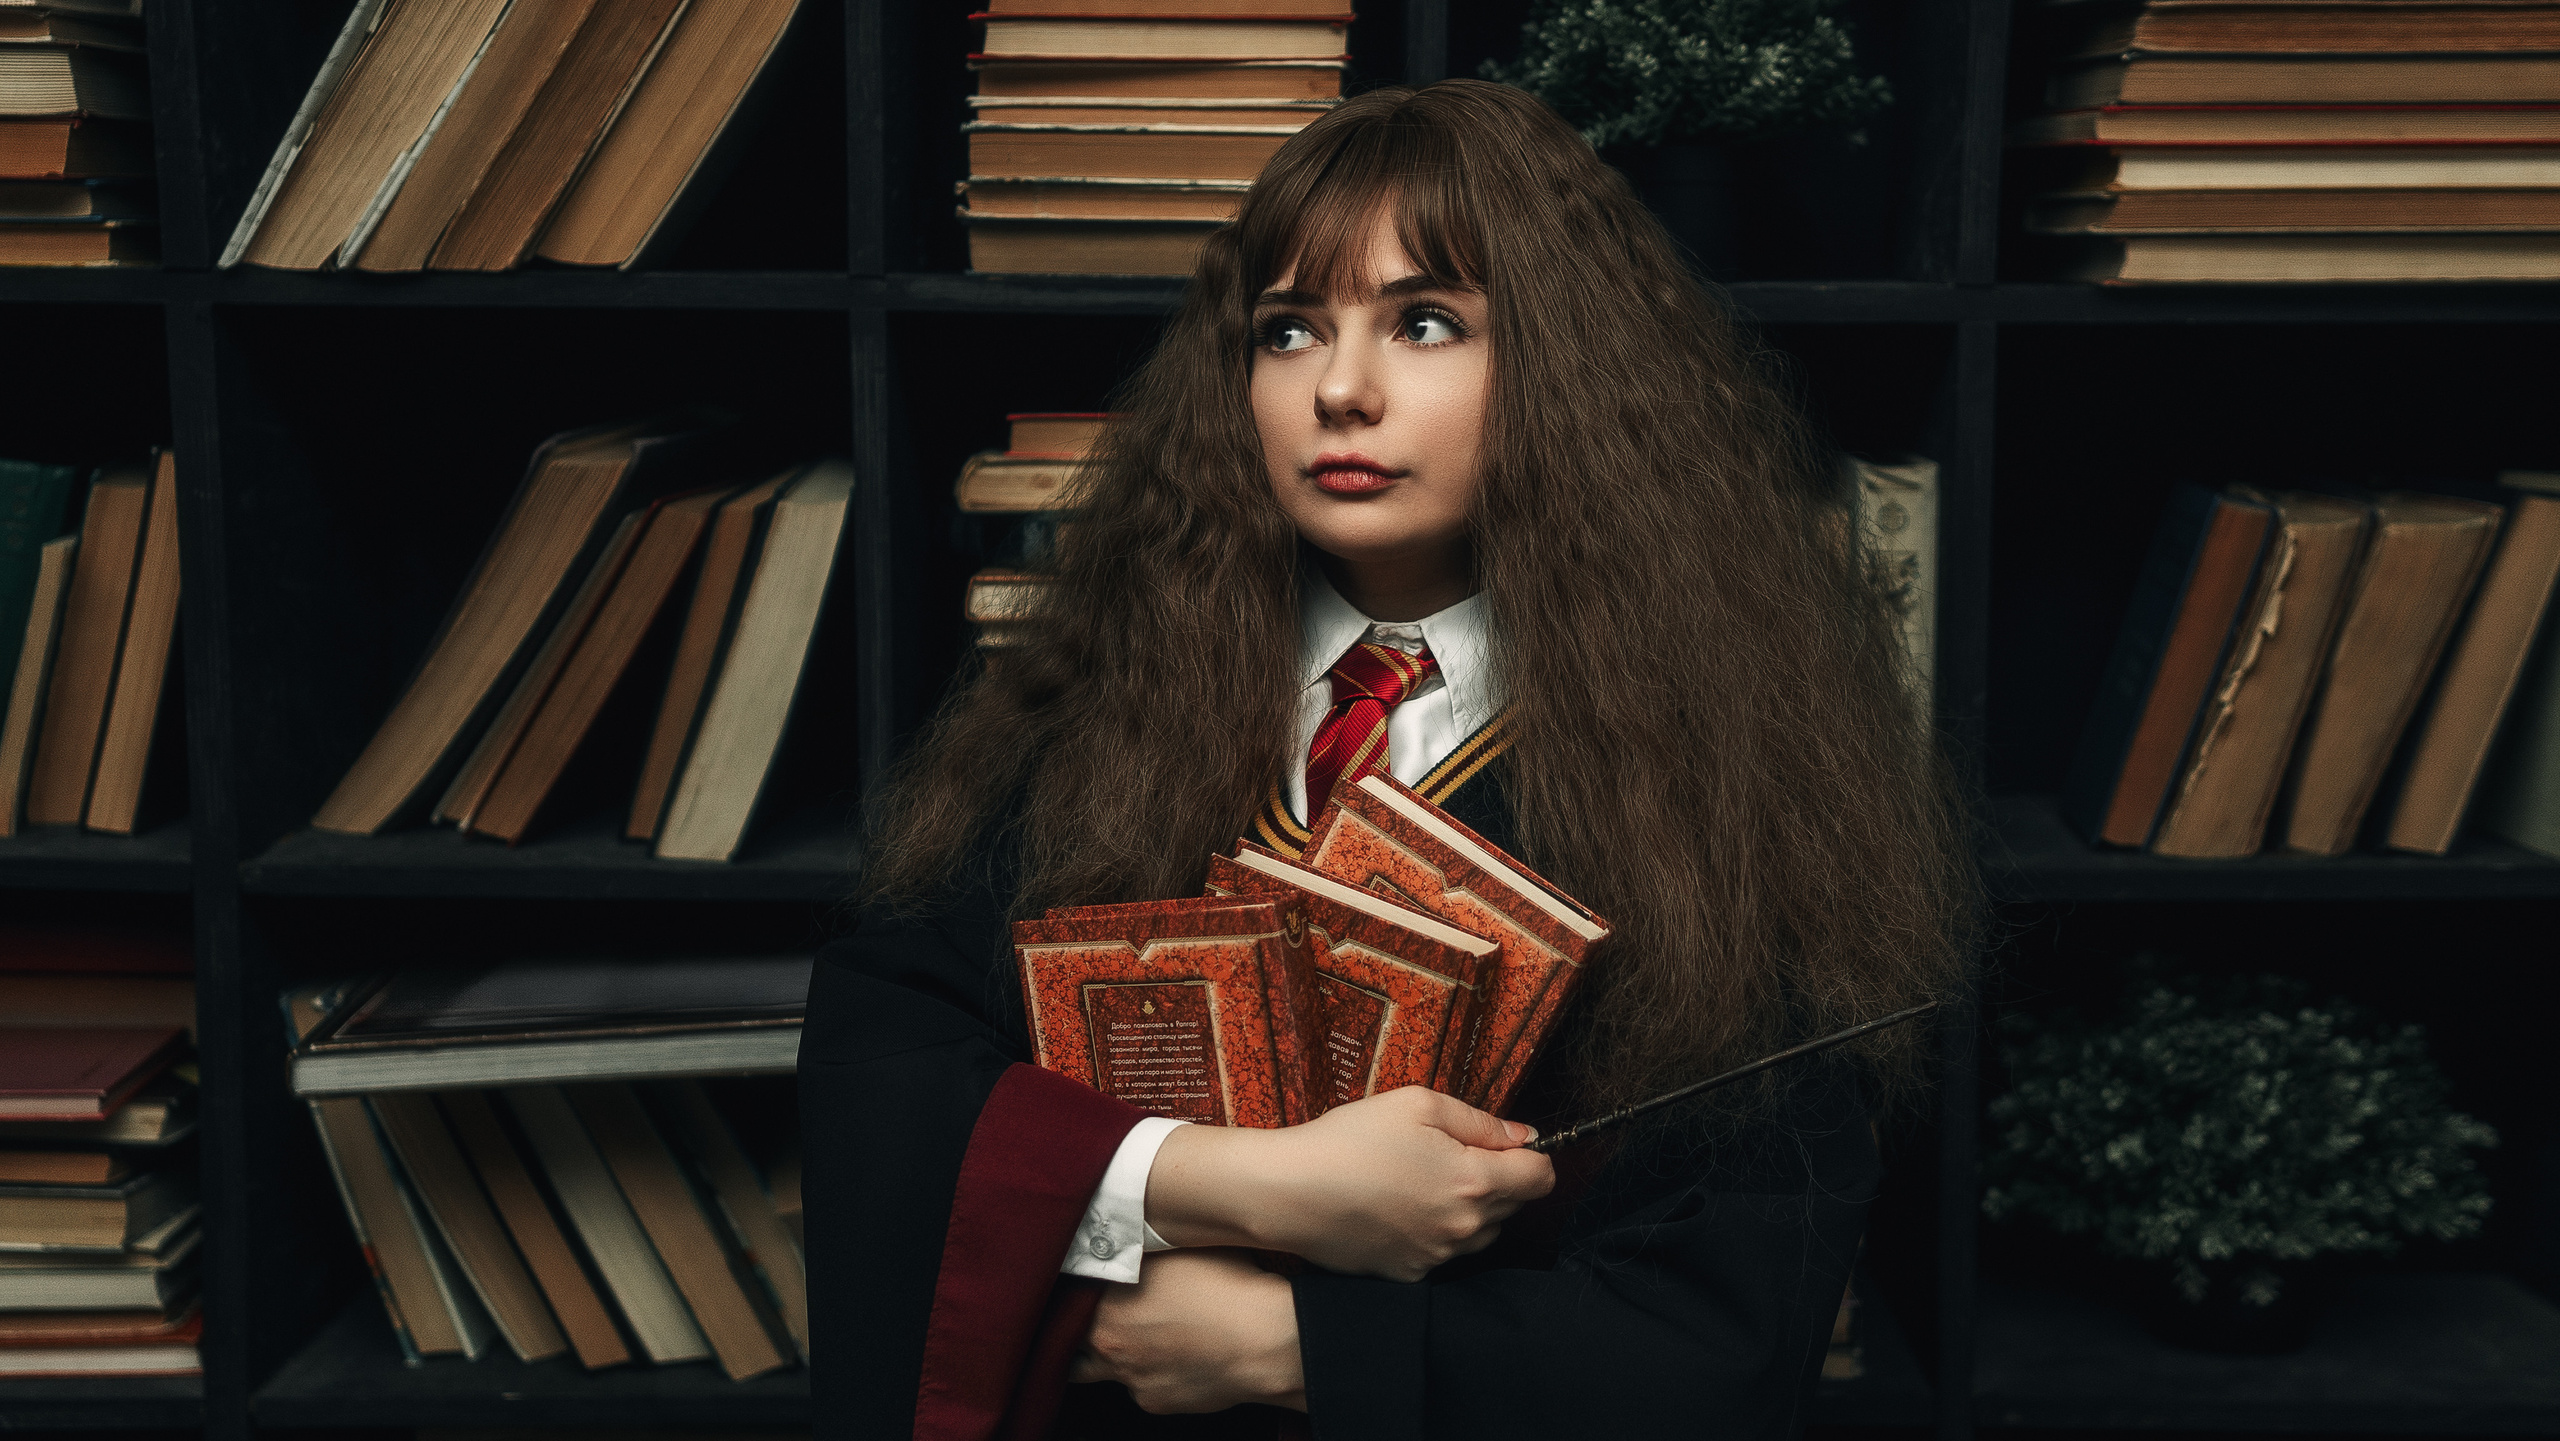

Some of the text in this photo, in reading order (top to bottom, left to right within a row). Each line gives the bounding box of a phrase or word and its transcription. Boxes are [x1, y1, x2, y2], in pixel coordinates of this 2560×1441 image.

[1318, 986, 1333, 997] РАЖ
[1111, 1021, 1132, 1030] Добро
[1107, 1034, 1152, 1042] Просвещенную
[1330, 1030, 1363, 1046] загадоч-
[1162, 1045, 1180, 1053] город
[1327, 1041, 1360, 1059] давая из
[1110, 1055, 1204, 1066] народов, королевство страстей,
[1331, 1052, 1338, 1061] В
[1185, 1067, 1206, 1075] Царст-
[1338, 1069, 1353, 1080] гор,
[1196, 1078, 1208, 1086] бок
[1333, 1079, 1351, 1091] ень,
[1116, 1093, 1138, 1101] лучшие
[1179, 1092, 1210, 1100] страшные
[1336, 1091, 1349, 1101] ом
